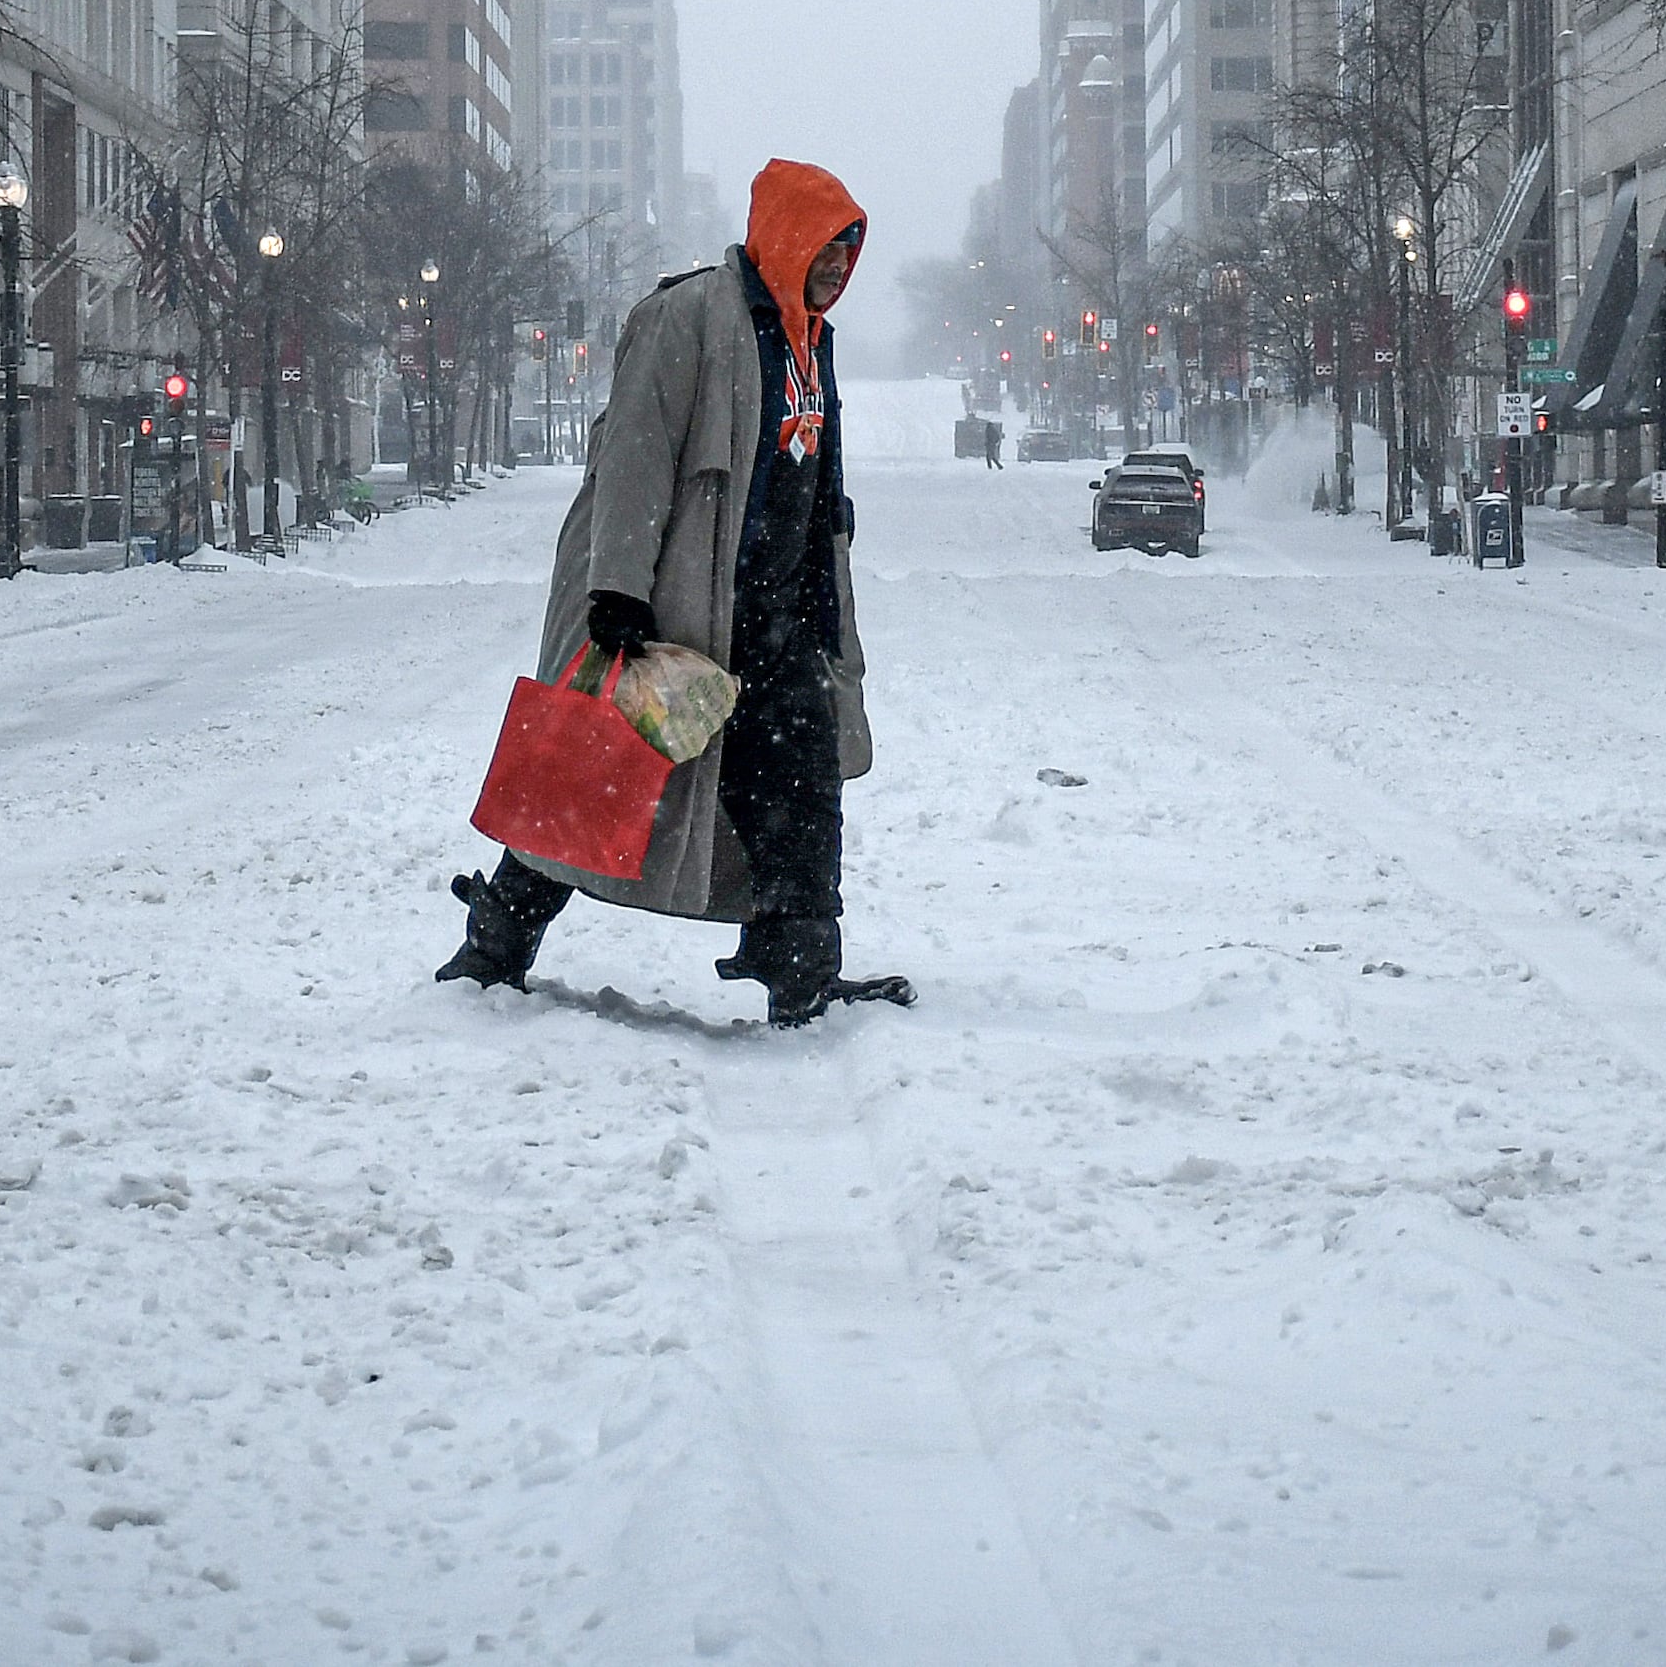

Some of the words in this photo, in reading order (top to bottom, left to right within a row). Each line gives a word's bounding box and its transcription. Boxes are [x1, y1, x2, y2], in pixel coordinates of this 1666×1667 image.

[1375, 352, 1393, 362] DC
[1315, 365, 1332, 375] DC
[282, 369, 302, 382] DC
[1506, 395, 1521, 404] NO
